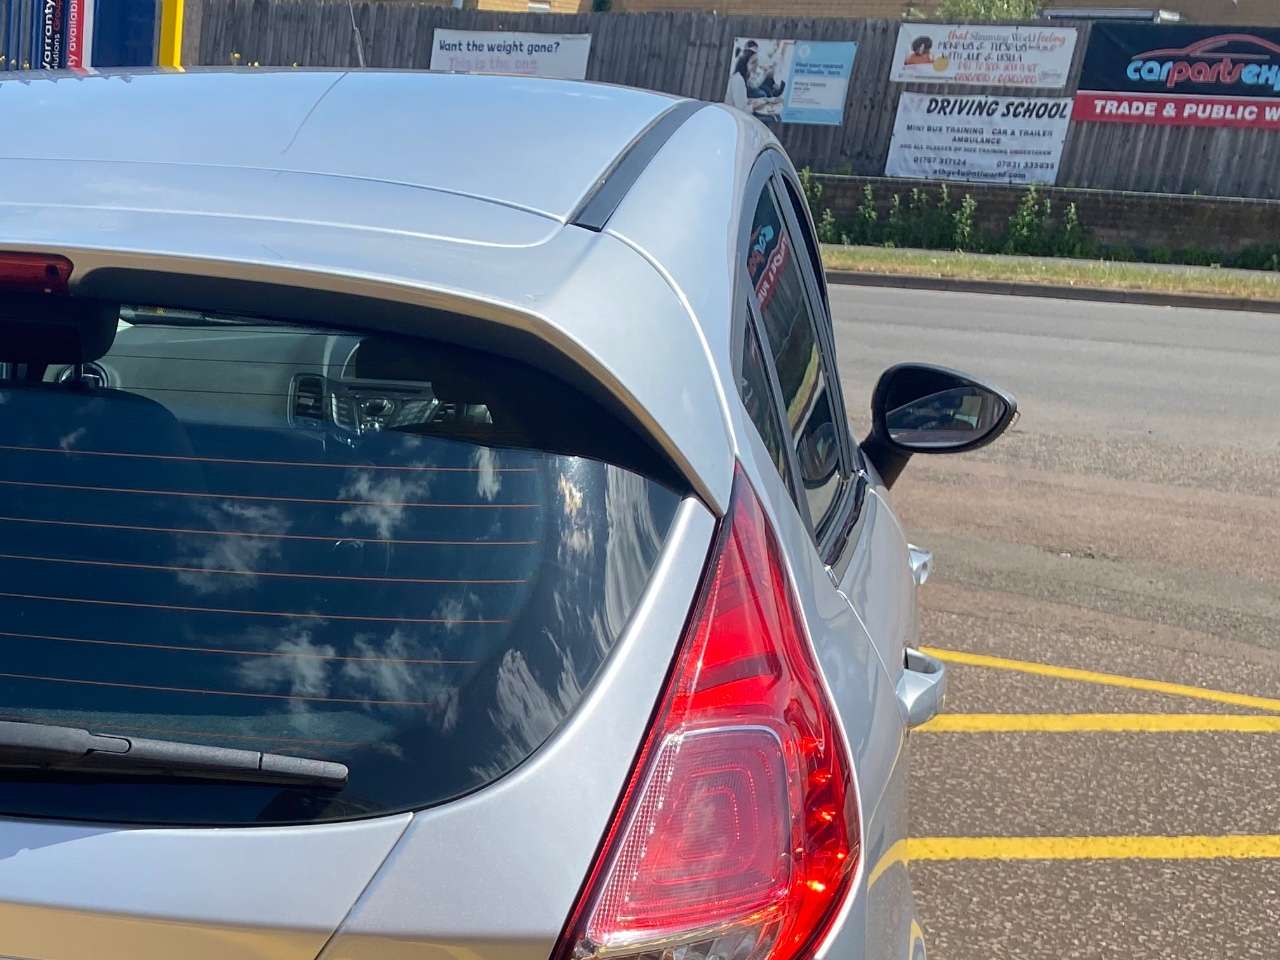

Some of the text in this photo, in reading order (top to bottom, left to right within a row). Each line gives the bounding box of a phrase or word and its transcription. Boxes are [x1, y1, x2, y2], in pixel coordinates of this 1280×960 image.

[439, 40, 560, 55] Want the weight gone?
[927, 98, 999, 118] DRIVING
[1001, 100, 1068, 119] SCHOOL
[1094, 100, 1157, 116] TRADE
[1163, 102, 1176, 117] &
[1183, 103, 1257, 121] PUBLIC
[945, 126, 984, 135] TRAINING
[952, 137, 1002, 145] AMBULANCE
